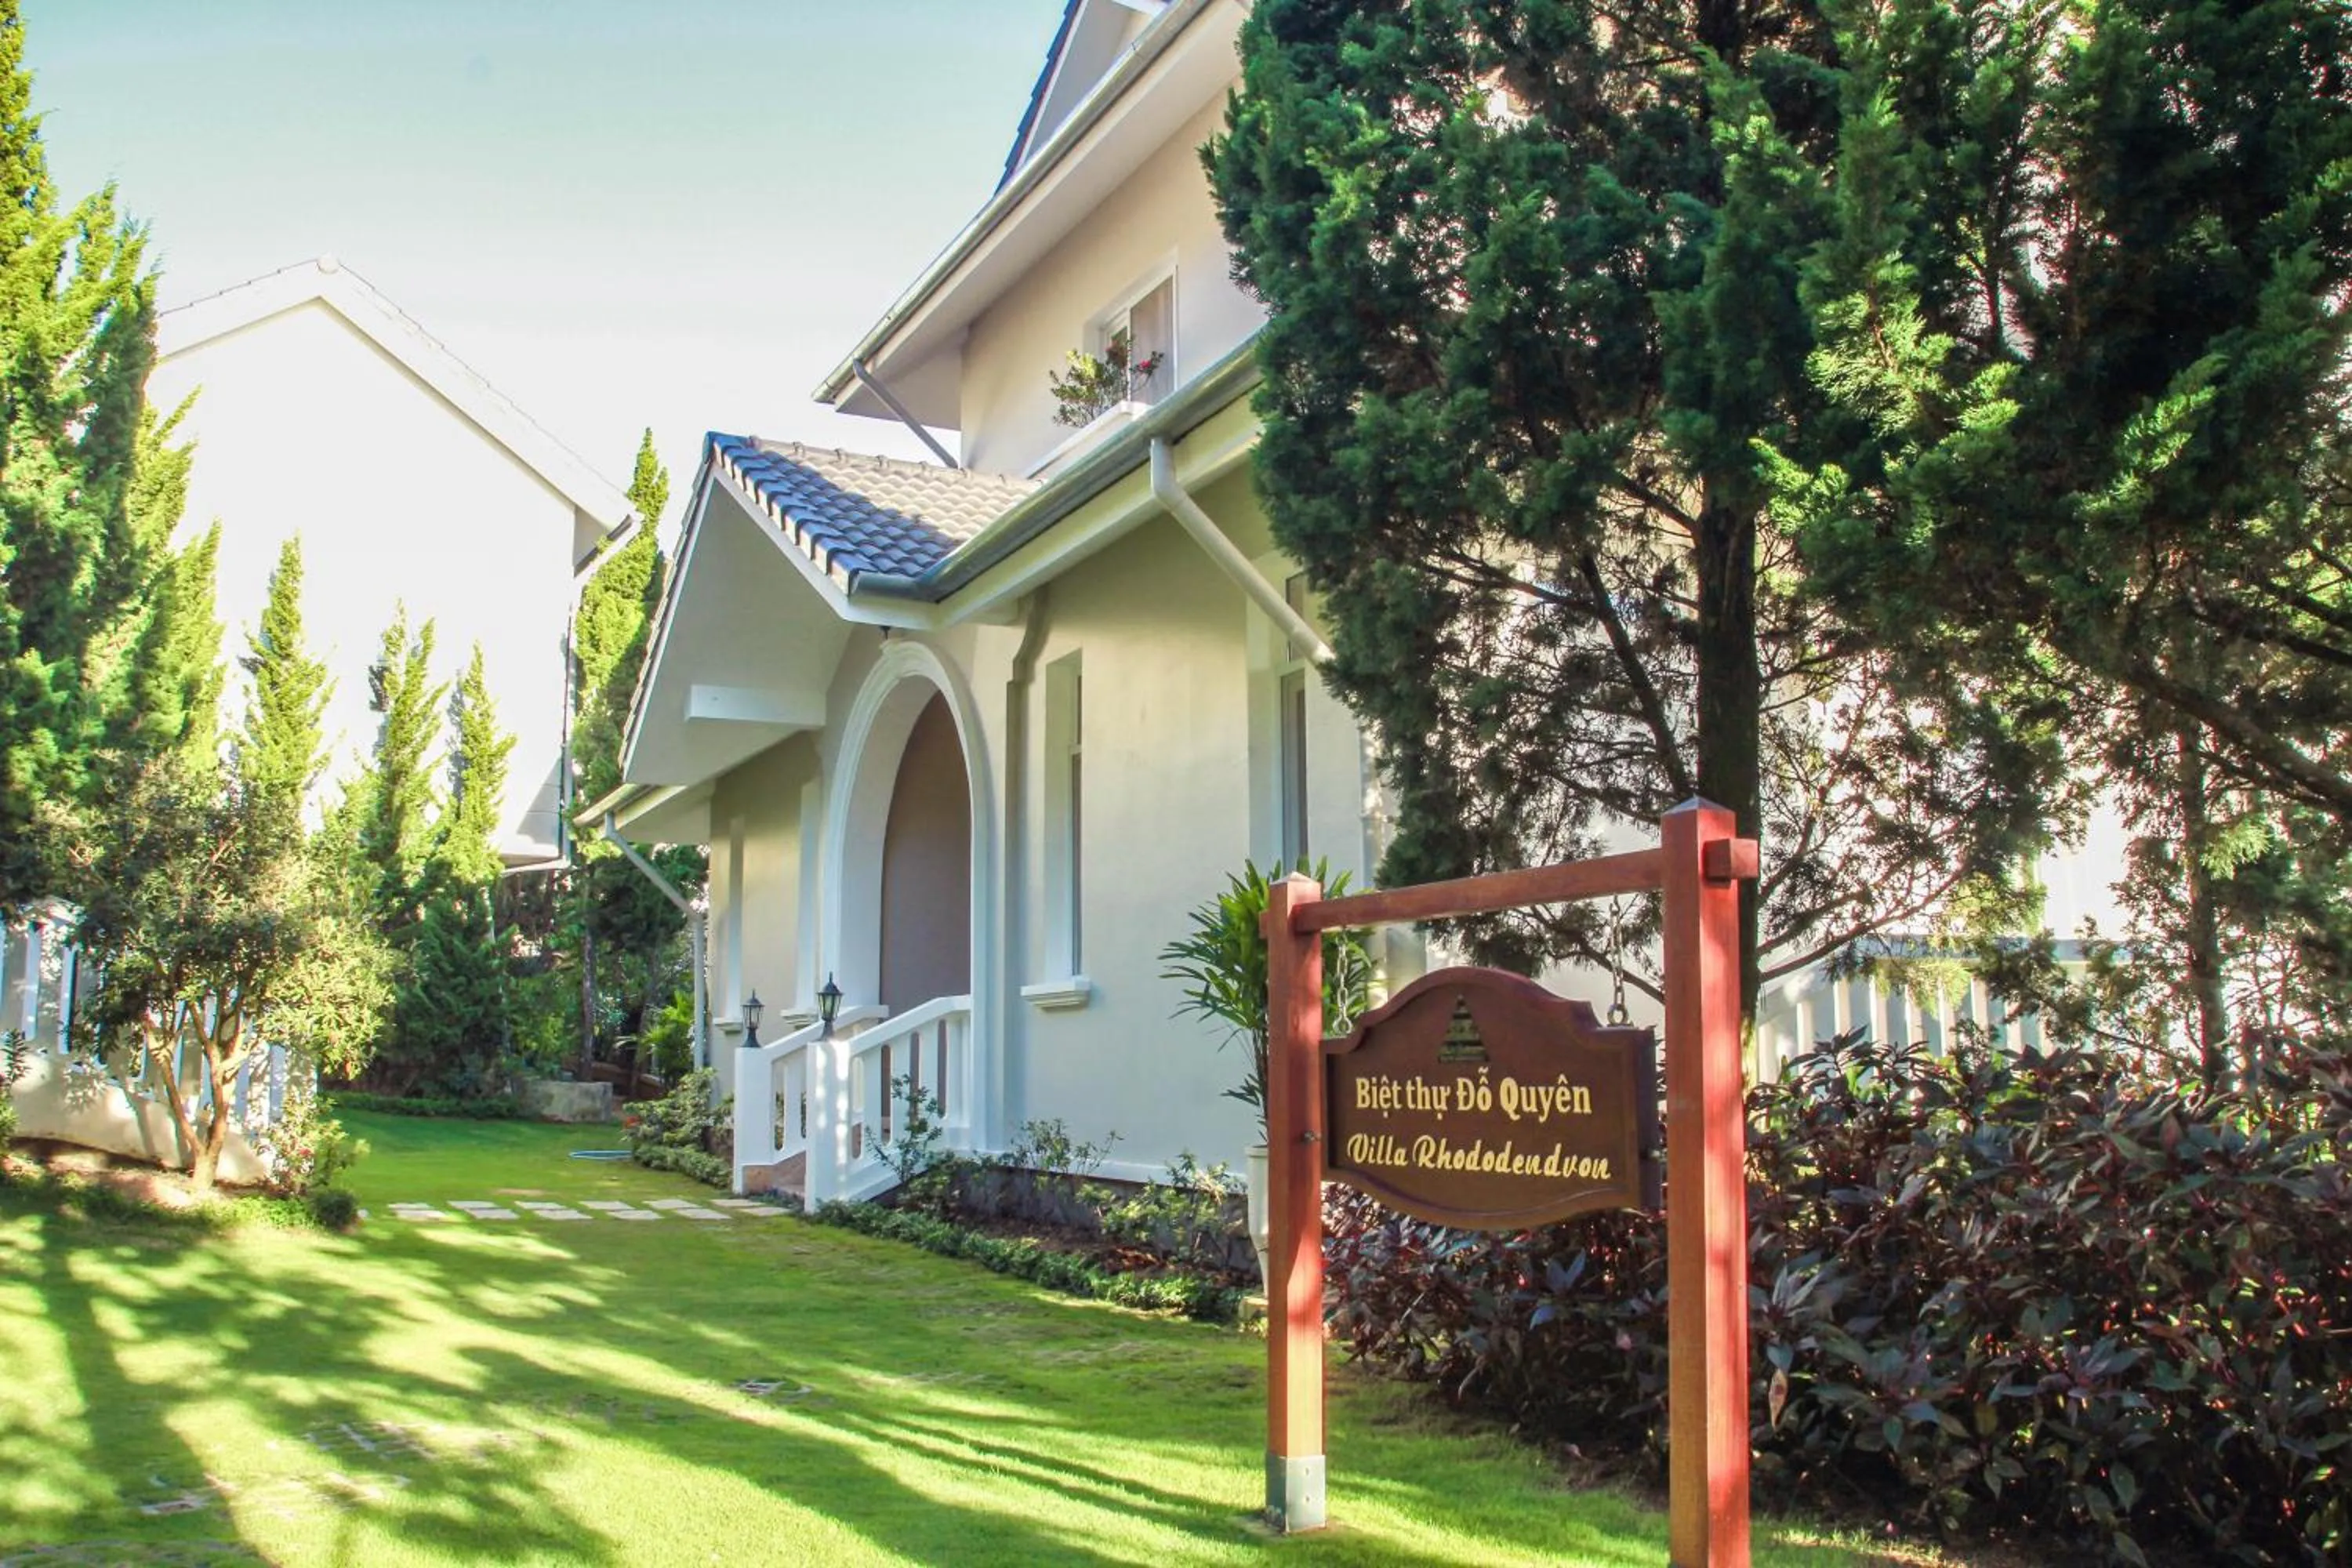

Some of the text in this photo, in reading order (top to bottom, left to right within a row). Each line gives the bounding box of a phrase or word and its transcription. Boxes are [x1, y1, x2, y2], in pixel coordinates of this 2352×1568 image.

[1355, 1066, 1592, 1123] Biệt thự Đỗ Quyên
[1347, 1133, 1408, 1167] Villa
